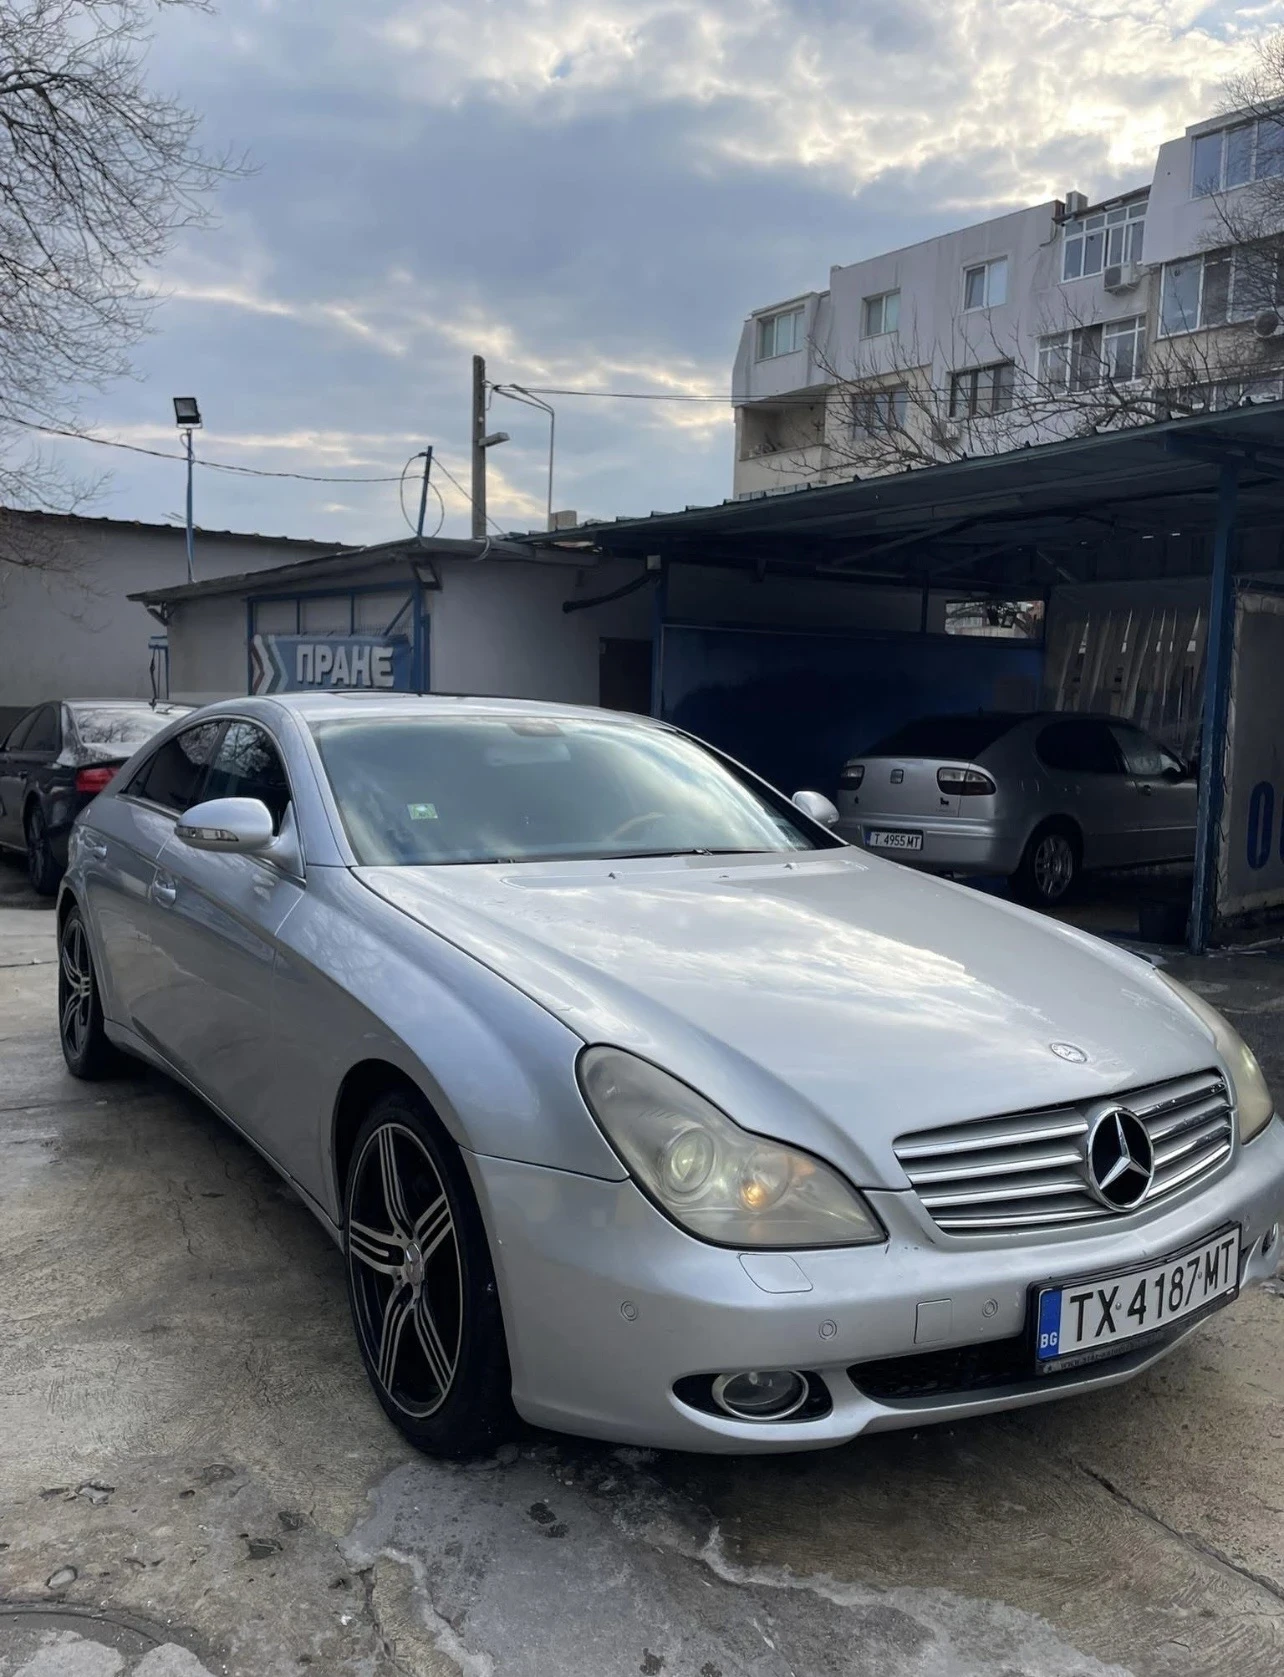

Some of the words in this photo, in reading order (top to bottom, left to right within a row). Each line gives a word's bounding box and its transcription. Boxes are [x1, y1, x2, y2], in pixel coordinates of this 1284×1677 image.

[296, 644, 395, 687] ПРАНЕ
[874, 833, 881, 845] T
[883, 834, 906, 847] 4955
[906, 835, 920, 848] MT
[1069, 1285, 1120, 1342] TX
[1126, 1255, 1201, 1325] 4187
[1203, 1237, 1235, 1296] MT
[1040, 1331, 1059, 1349] BG
